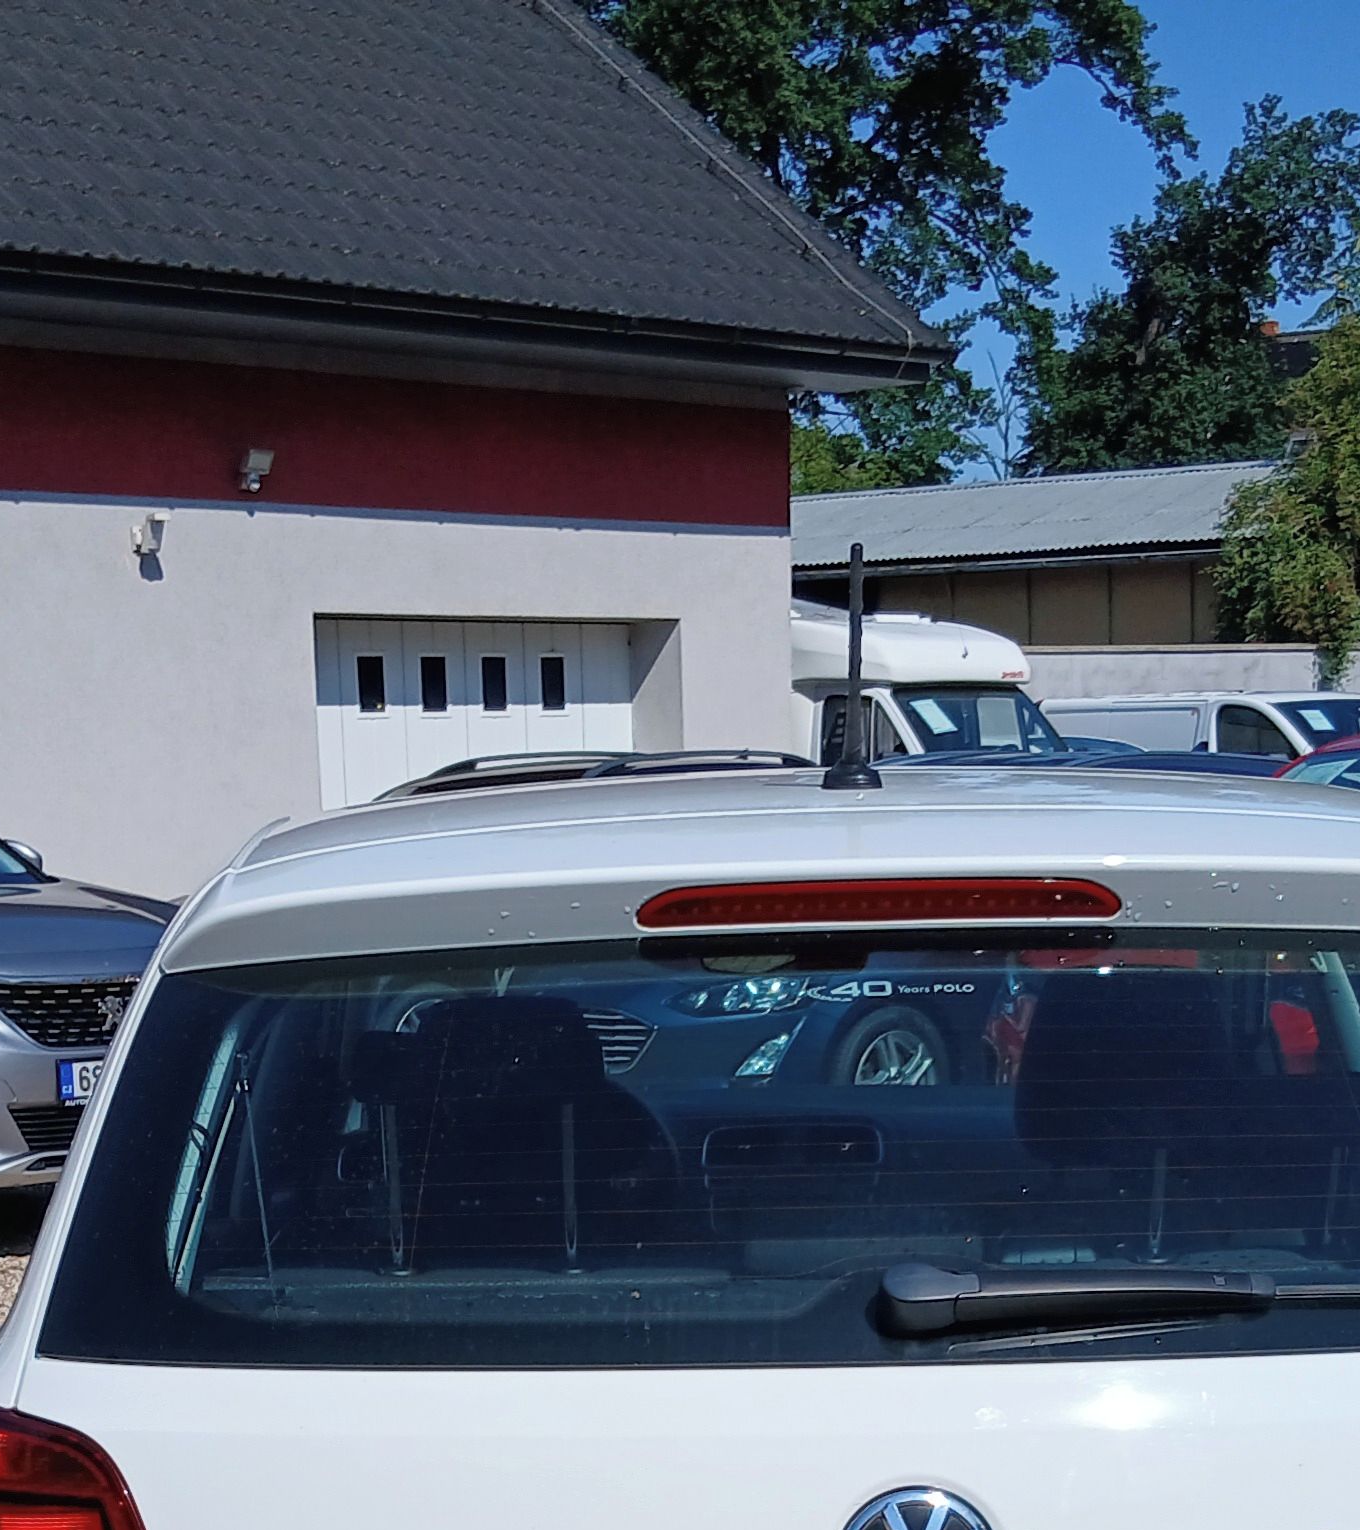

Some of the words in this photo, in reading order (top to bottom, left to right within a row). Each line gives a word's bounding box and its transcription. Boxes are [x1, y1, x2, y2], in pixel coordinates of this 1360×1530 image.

[830, 981, 892, 997] 40
[898, 985, 930, 993] Years
[934, 984, 974, 993] POLO
